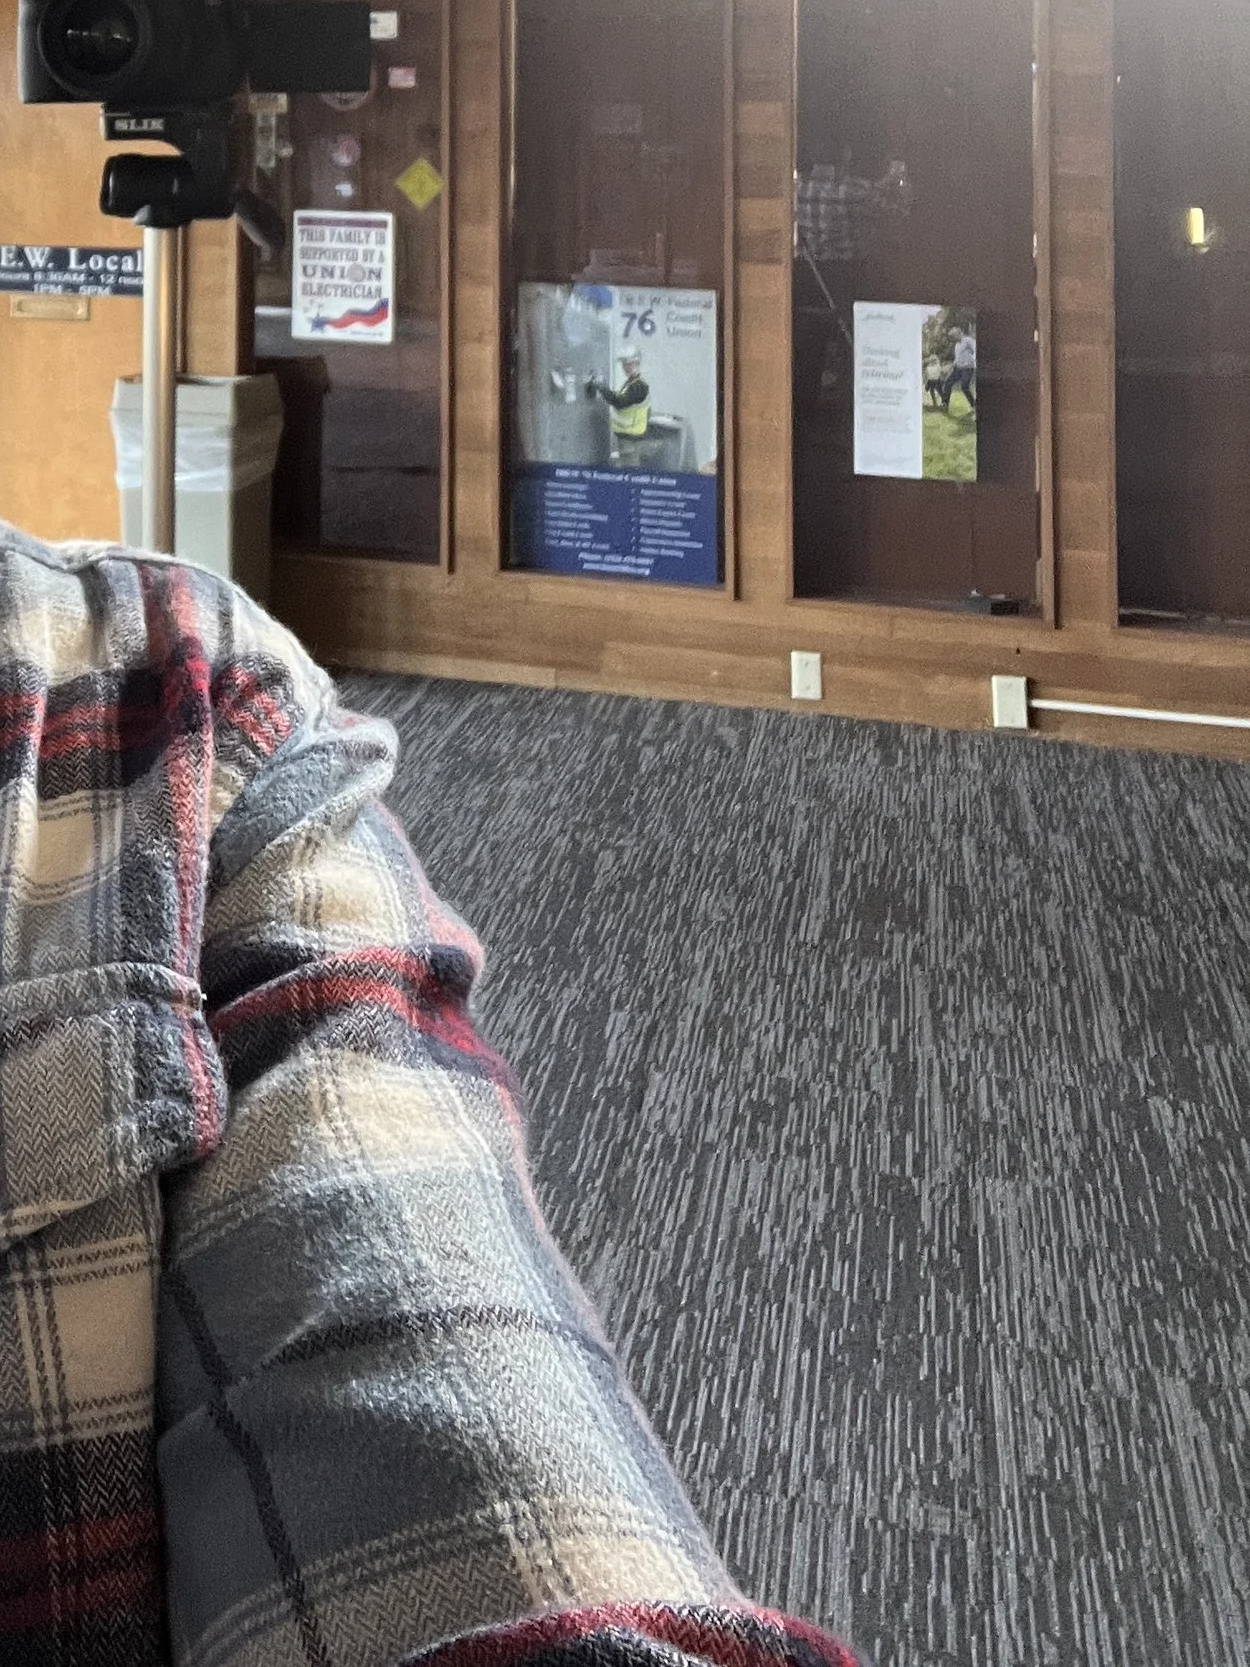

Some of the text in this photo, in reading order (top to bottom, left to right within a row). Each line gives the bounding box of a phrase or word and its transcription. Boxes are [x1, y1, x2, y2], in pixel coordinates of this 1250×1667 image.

[114, 117, 165, 131] SLIK
[298, 227, 326, 243] THIS
[328, 229, 372, 244] FAMILY
[68, 247, 143, 273] Local
[299, 245, 386, 264] SUPPORTED BY A
[301, 282, 383, 299] ELECTRICIAN
[621, 309, 657, 339] 76
